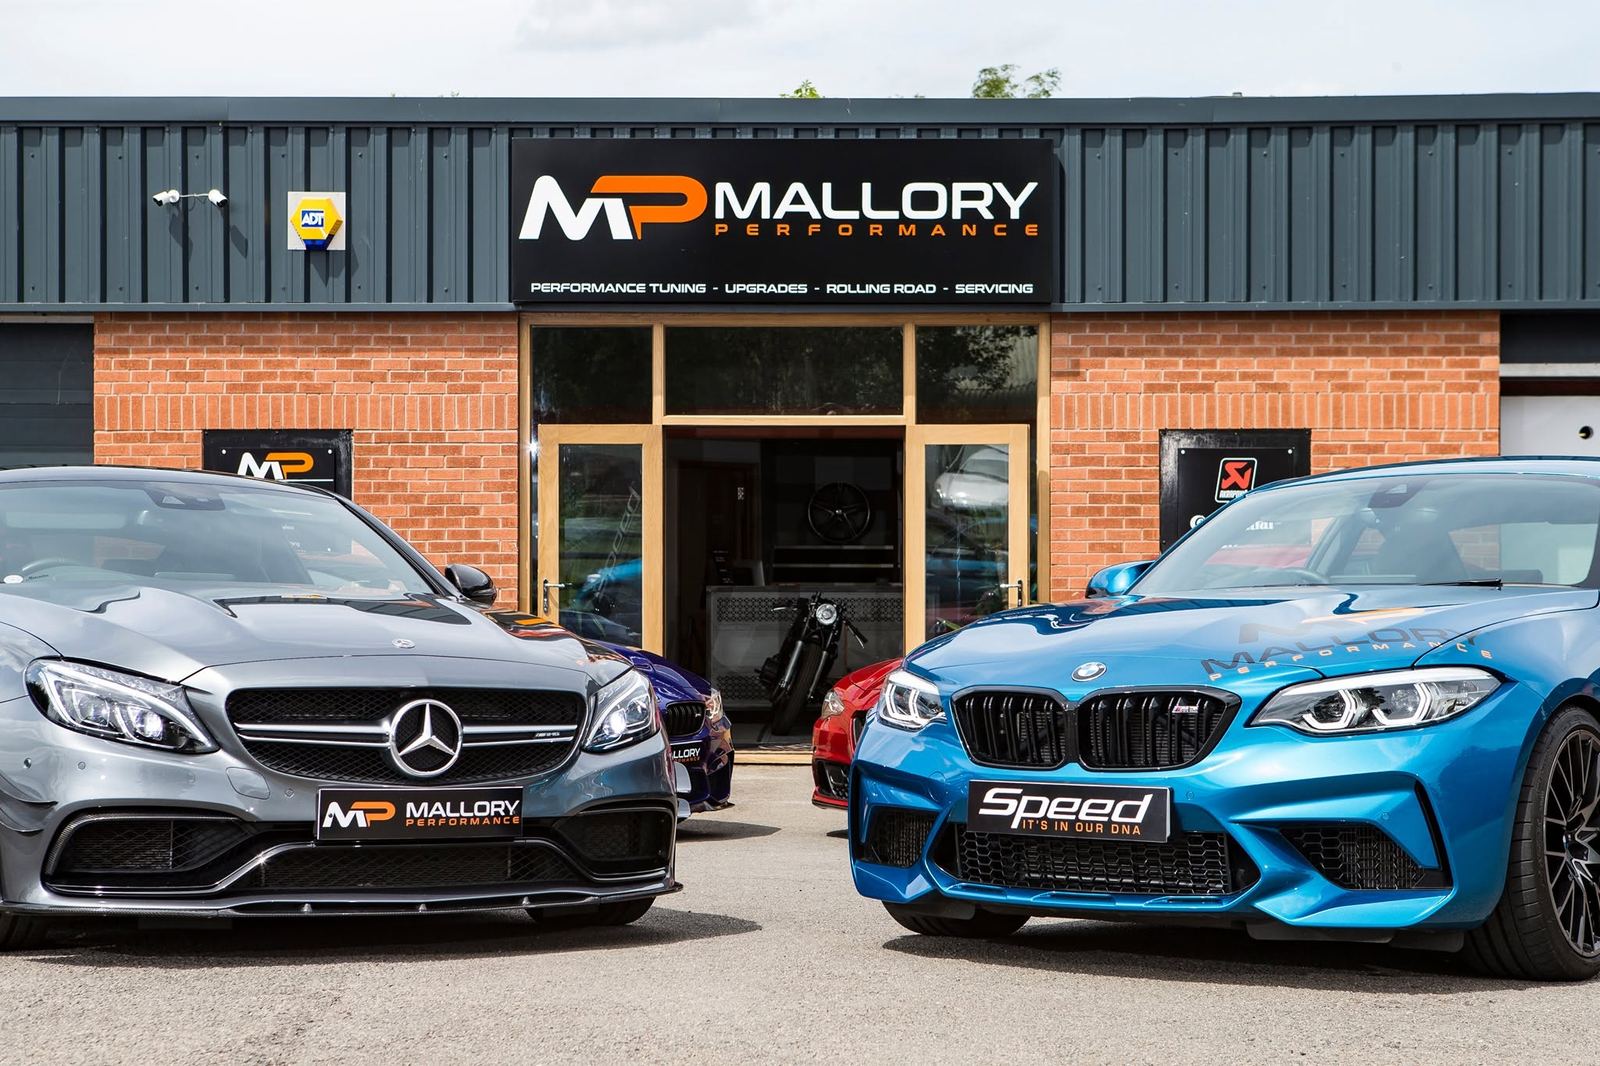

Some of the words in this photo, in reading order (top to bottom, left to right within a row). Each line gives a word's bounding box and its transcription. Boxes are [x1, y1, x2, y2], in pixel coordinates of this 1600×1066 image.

[715, 182, 1038, 219] MALLORY
[301, 212, 324, 225] ADT
[715, 224, 1038, 236] PERFORMANCE
[530, 282, 646, 294] PERFORMANCE
[649, 283, 706, 294] TUNING
[725, 283, 807, 294] UPGRADES
[826, 283, 891, 294] ROLLING
[893, 283, 936, 294] ROAD
[955, 283, 1034, 294] SERVICING
[1201, 628, 1477, 675] MALLORY
[672, 748, 701, 759] LLORY
[406, 800, 519, 818] MALLORY
[979, 787, 1153, 829] Speed
[406, 816, 520, 827] PERFORMANCE
[1022, 819, 1048, 831] IT'S
[1054, 821, 1069, 832] IN
[1075, 823, 1104, 834] OUR
[1111, 824, 1142, 836] DNA
